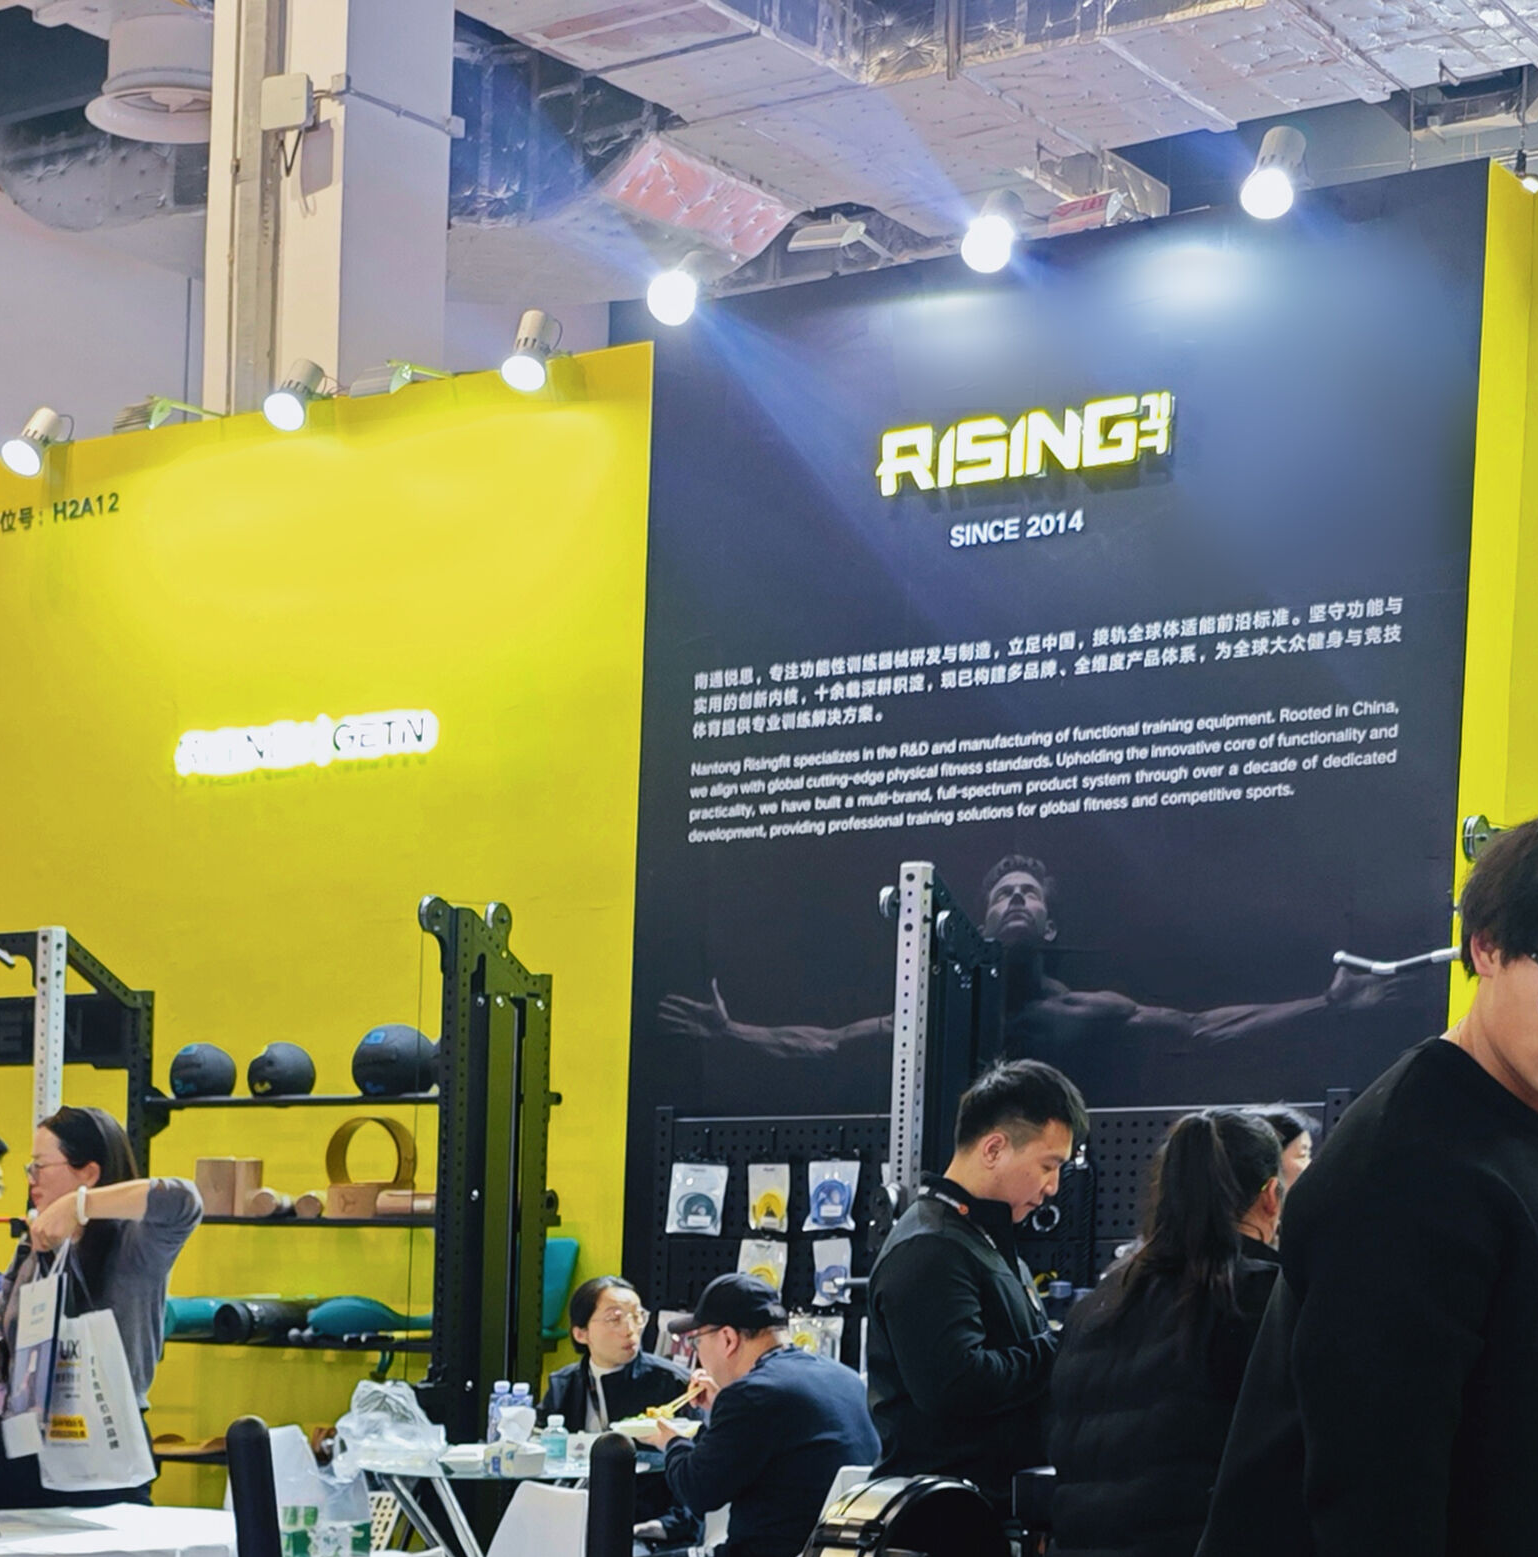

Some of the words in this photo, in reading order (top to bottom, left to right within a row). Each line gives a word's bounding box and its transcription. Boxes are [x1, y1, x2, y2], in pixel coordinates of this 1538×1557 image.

[874, 394, 1141, 497] RISING
[949, 516, 1020, 549] SINCE
[1025, 508, 1085, 538] 2014
[690, 757, 741, 777] Nantong
[793, 748, 860, 768] specializes
[863, 746, 874, 761] in
[876, 744, 897, 760] the
[900, 740, 928, 757] R&D
[931, 738, 956, 755] and
[958, 729, 1053, 752] manufacturing
[1055, 726, 1071, 744] of
[1072, 721, 1140, 743] functional
[1142, 717, 1194, 736] training
[1196, 710, 1276, 732] equipment.
[1279, 703, 1332, 723] Rooted
[1335, 702, 1349, 718] in
[1352, 699, 1399, 717] China,
[690, 784, 708, 799] we
[710, 779, 738, 799] align
[740, 776, 765, 795] with
[767, 774, 804, 794] global
[806, 769, 885, 791] cutting-edge
[886, 764, 938, 784] physical
[940, 760, 983, 778] fitness
[985, 753, 1053, 775] standards.
[1055, 747, 1124, 769] Upholding
[1126, 744, 1149, 762] the
[1151, 738, 1221, 759] innovative
[1223, 736, 1256, 752] core
[1258, 732, 1276, 749] of
[1277, 726, 1367, 749] functionality
[1369, 723, 1399, 741] and
[687, 824, 768, 844] development,
[769, 818, 826, 840] providing
[828, 811, 904, 835] professional
[906, 809, 955, 828] training
[956, 803, 1014, 824] solutions
[1016, 801, 1037, 818] for
[1039, 798, 1081, 819] global
[1083, 795, 1128, 813] fitness
[1131, 791, 1158, 809] and
[1160, 786, 1243, 806] competitive
[1245, 782, 1295, 802] sports.
[689, 803, 756, 824] practicality,
[758, 800, 778, 816] we
[780, 796, 811, 814] have
[814, 793, 841, 811] built
[843, 796, 854, 809] a
[856, 786, 934, 808] multi-brand,
[936, 779, 1023, 803] full-spectrum
[1025, 774, 1079, 797] product
[1081, 771, 1132, 792] system
[1135, 765, 1188, 786] through
[1192, 764, 1225, 780] over
[1228, 763, 1240, 777] a
[1243, 755, 1297, 776] decade
[1301, 753, 1319, 771] of
[1322, 748, 1398, 770] dedicated
